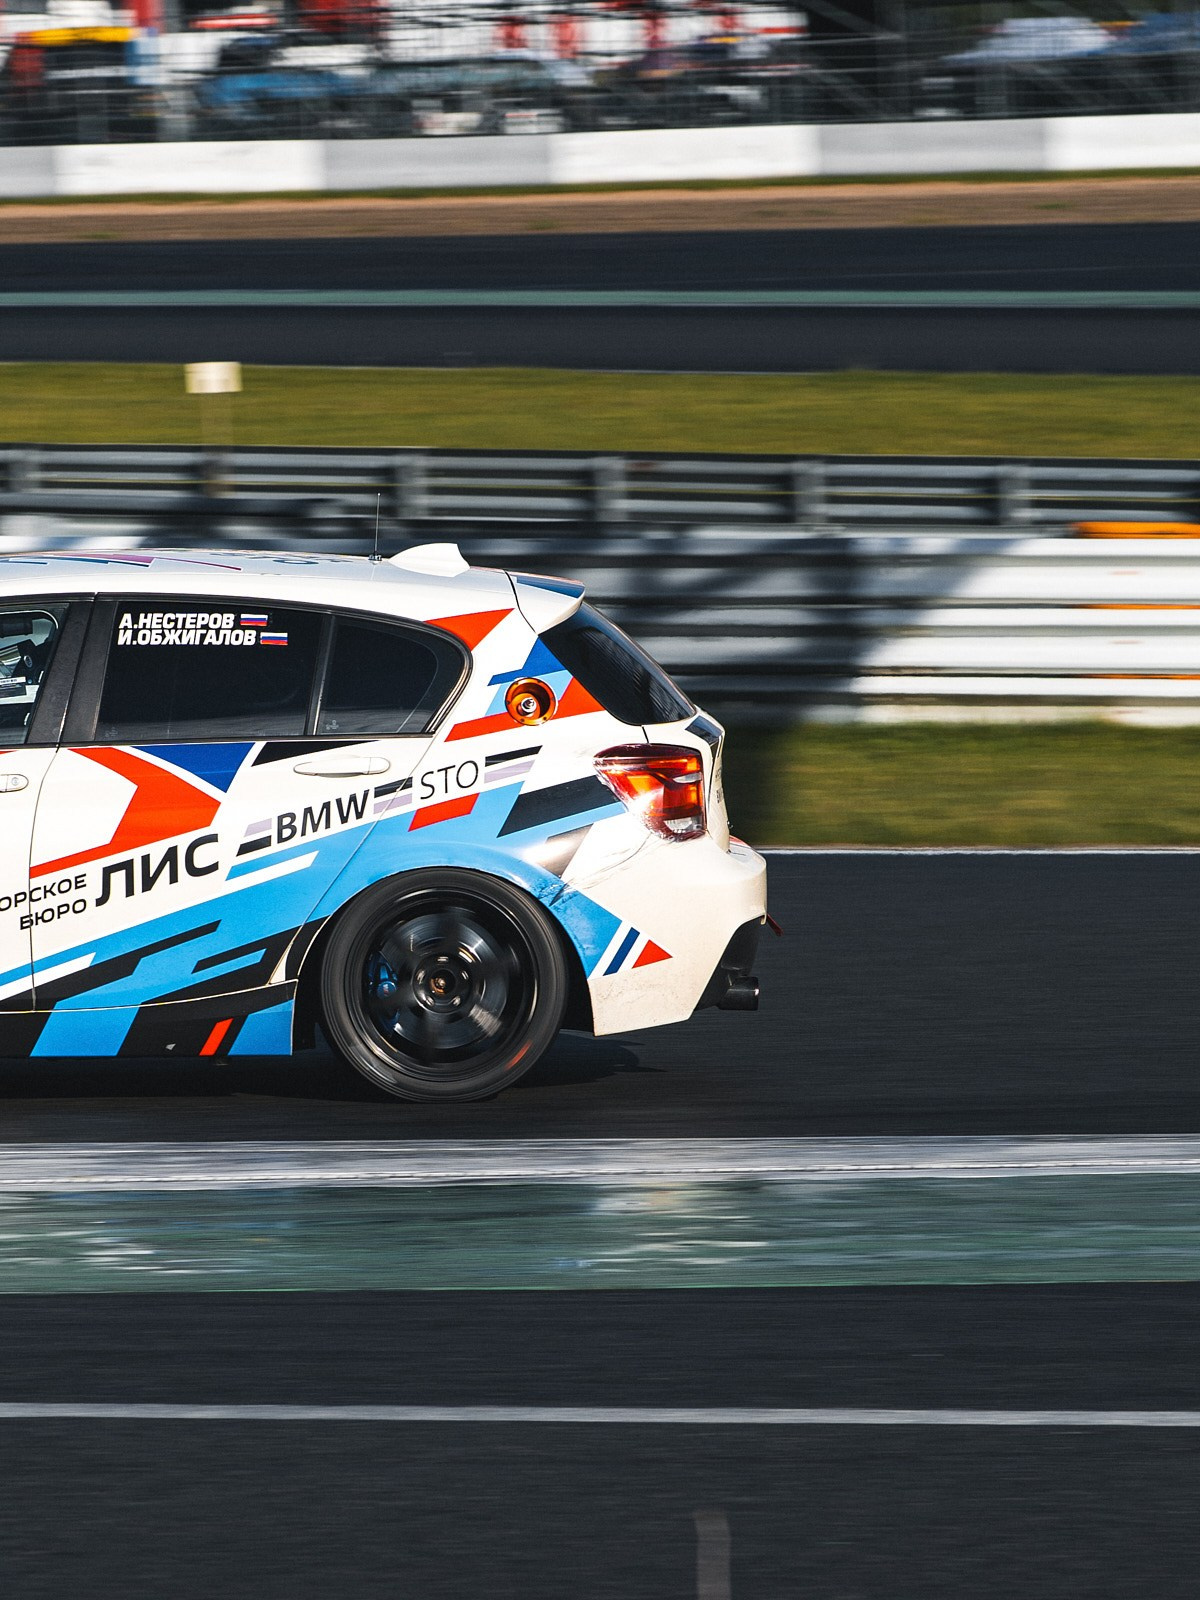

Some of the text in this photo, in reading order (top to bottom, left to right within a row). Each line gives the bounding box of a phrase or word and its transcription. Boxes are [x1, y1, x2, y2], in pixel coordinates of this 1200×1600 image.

[117, 629, 257, 646] И.ОБЖИГАЛОВ
[119, 613, 235, 629] А.НЕСТЕРОВ
[276, 760, 479, 844] BMW STO
[95, 833, 220, 908] ЛИС
[19, 898, 88, 931] БЮРО
